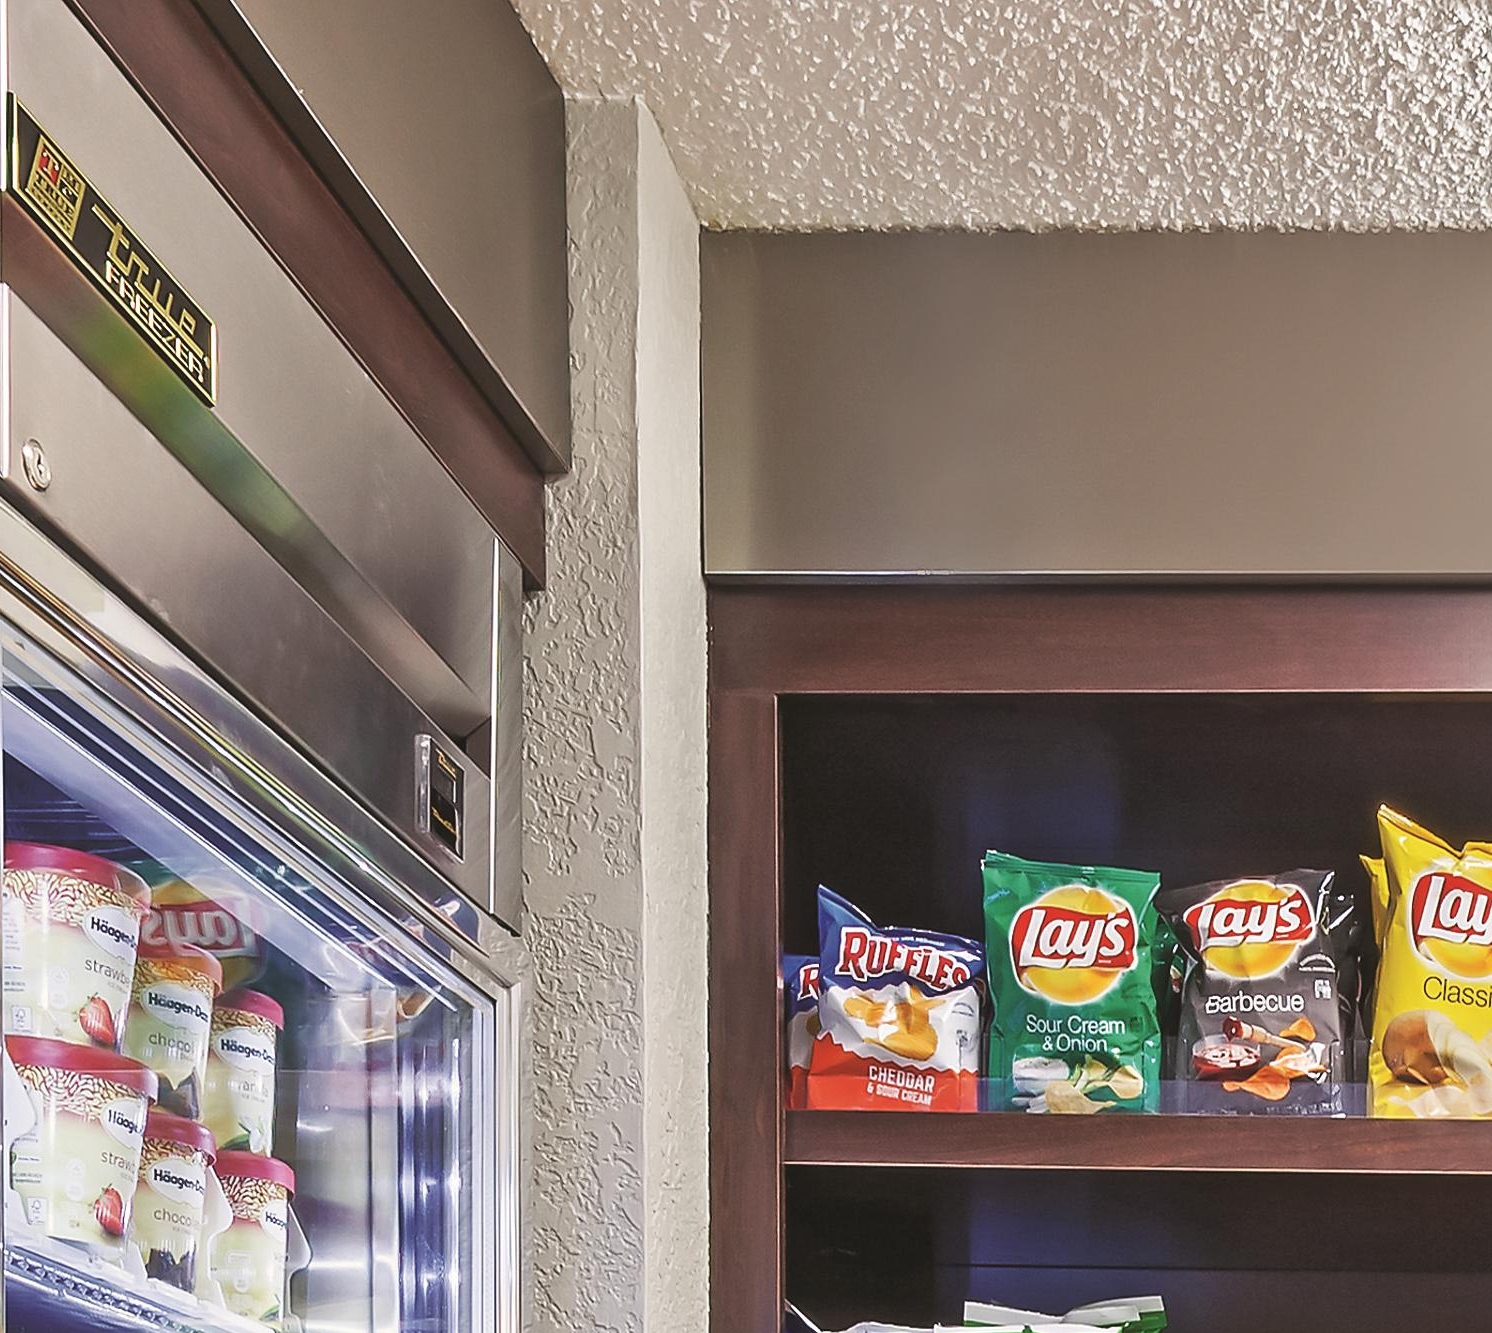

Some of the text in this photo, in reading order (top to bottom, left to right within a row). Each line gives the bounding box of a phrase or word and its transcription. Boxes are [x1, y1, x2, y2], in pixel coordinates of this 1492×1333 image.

[106, 261, 203, 382] FREEZER
[1013, 907, 1136, 970] Lay's
[836, 927, 971, 992] RUFFLES
[1205, 992, 1304, 1014] Barbecue
[1027, 1015, 1125, 1036] Sour Cream
[1042, 1034, 1107, 1053] & Onion
[869, 1065, 935, 1094] CHEDDAR
